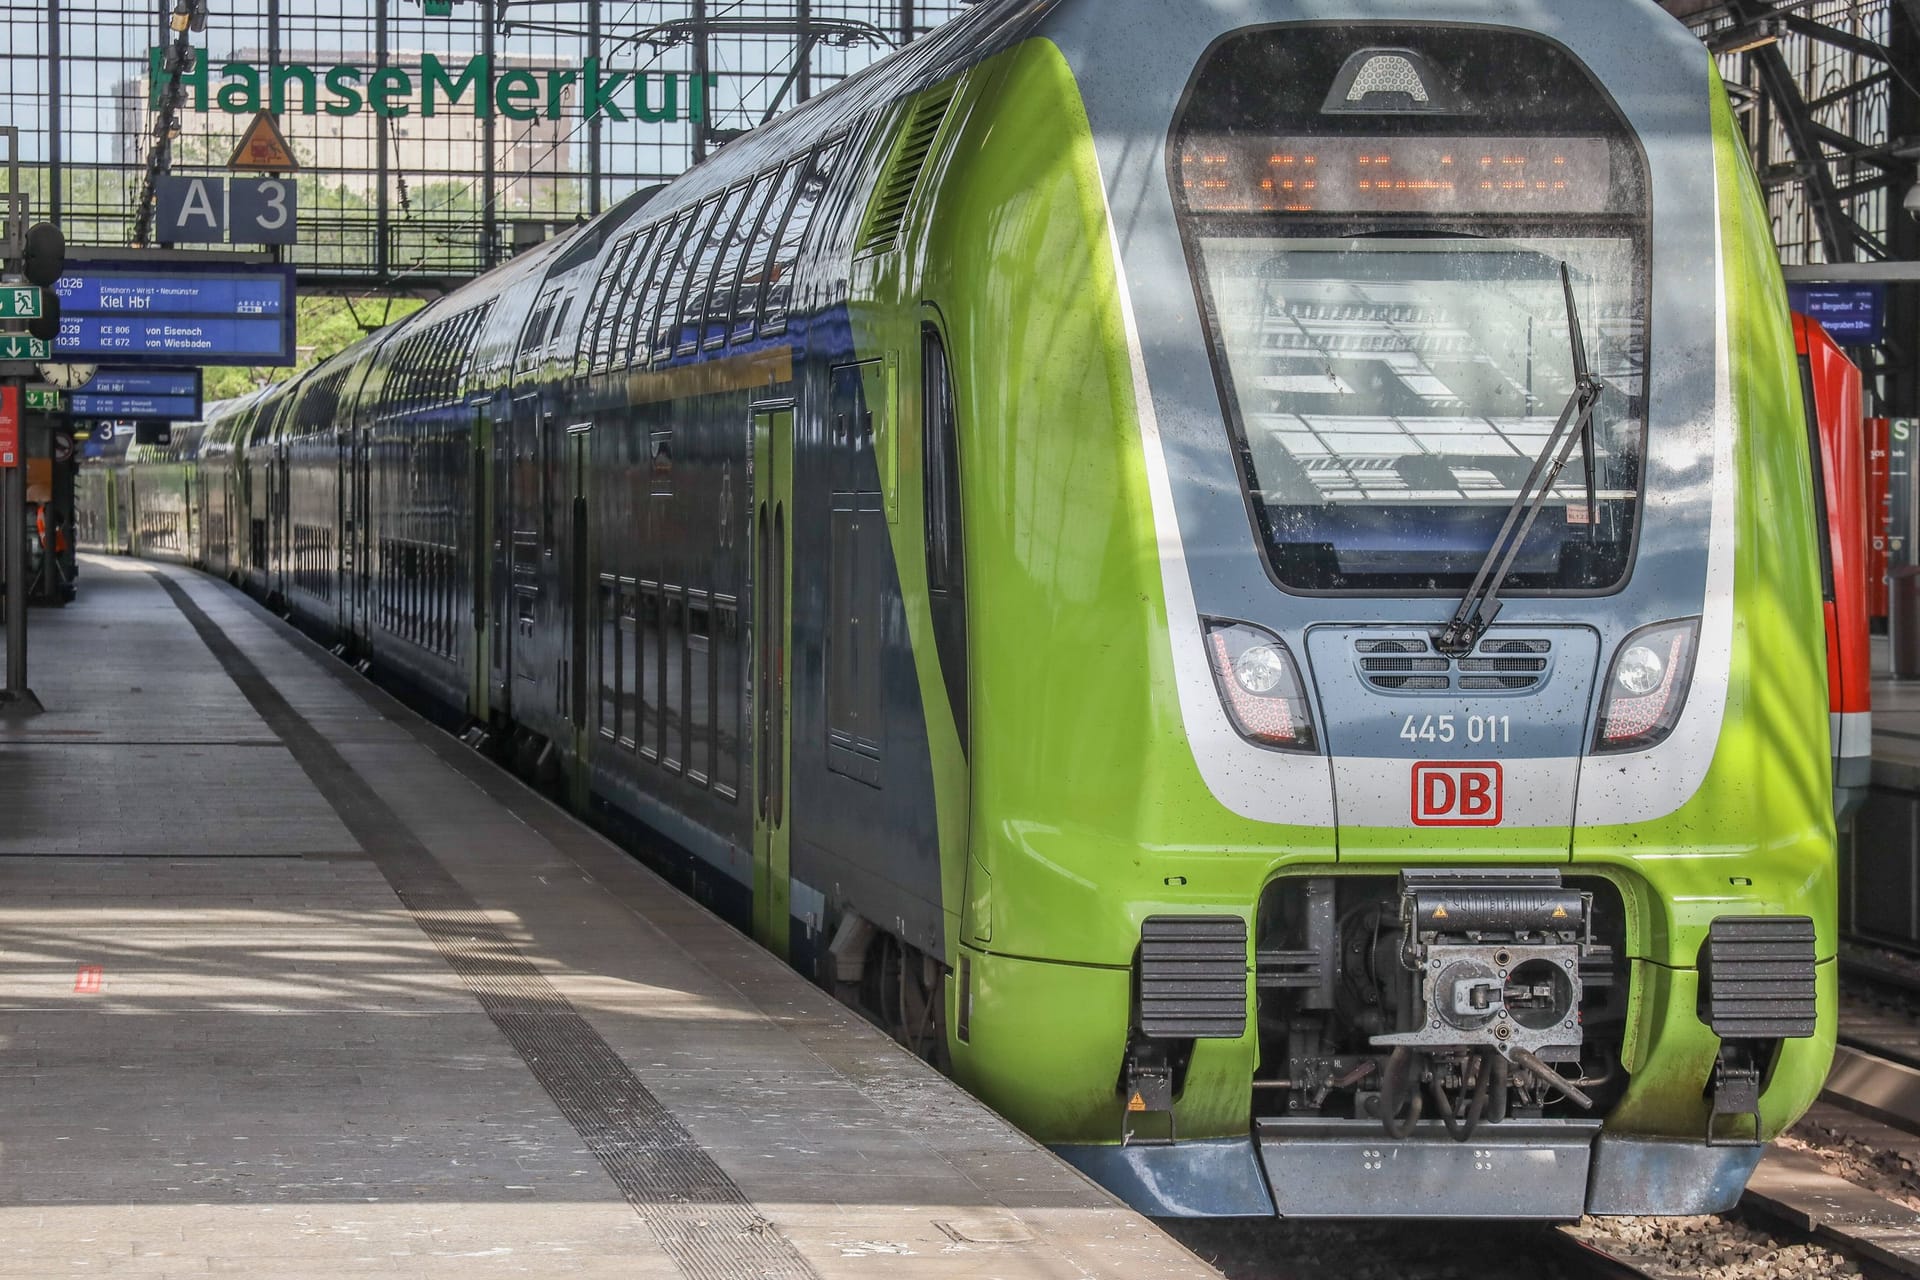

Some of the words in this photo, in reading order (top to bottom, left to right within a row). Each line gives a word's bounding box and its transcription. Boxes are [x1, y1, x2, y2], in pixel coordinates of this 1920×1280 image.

[150, 46, 717, 125] HanseMerkur
[176, 179, 218, 228] A
[255, 180, 289, 230] 3
[56, 277, 83, 289] 10:26
[100, 286, 131, 295] Elmshorn
[136, 287, 155, 295] Wrist
[160, 287, 200, 296] Neumünster
[100, 295, 124, 309] Kiel
[128, 295, 151, 309] Hbf
[60, 324, 81, 334] 0:29
[100, 326, 113, 334] ICE
[115, 326, 130, 334] 806
[145, 328, 161, 336] von
[164, 326, 202, 336] Eisenach
[55, 337, 80, 346] 10:35
[100, 338, 113, 346] ICE
[115, 338, 130, 346] 672
[145, 340, 161, 348] von
[164, 338, 212, 348] Wiesbaden
[100, 421, 113, 440] 3
[1894, 420, 1910, 440] S
[1400, 714, 1456, 743] 445
[1467, 714, 1511, 743] 011
[1421, 770, 1494, 817] DB
